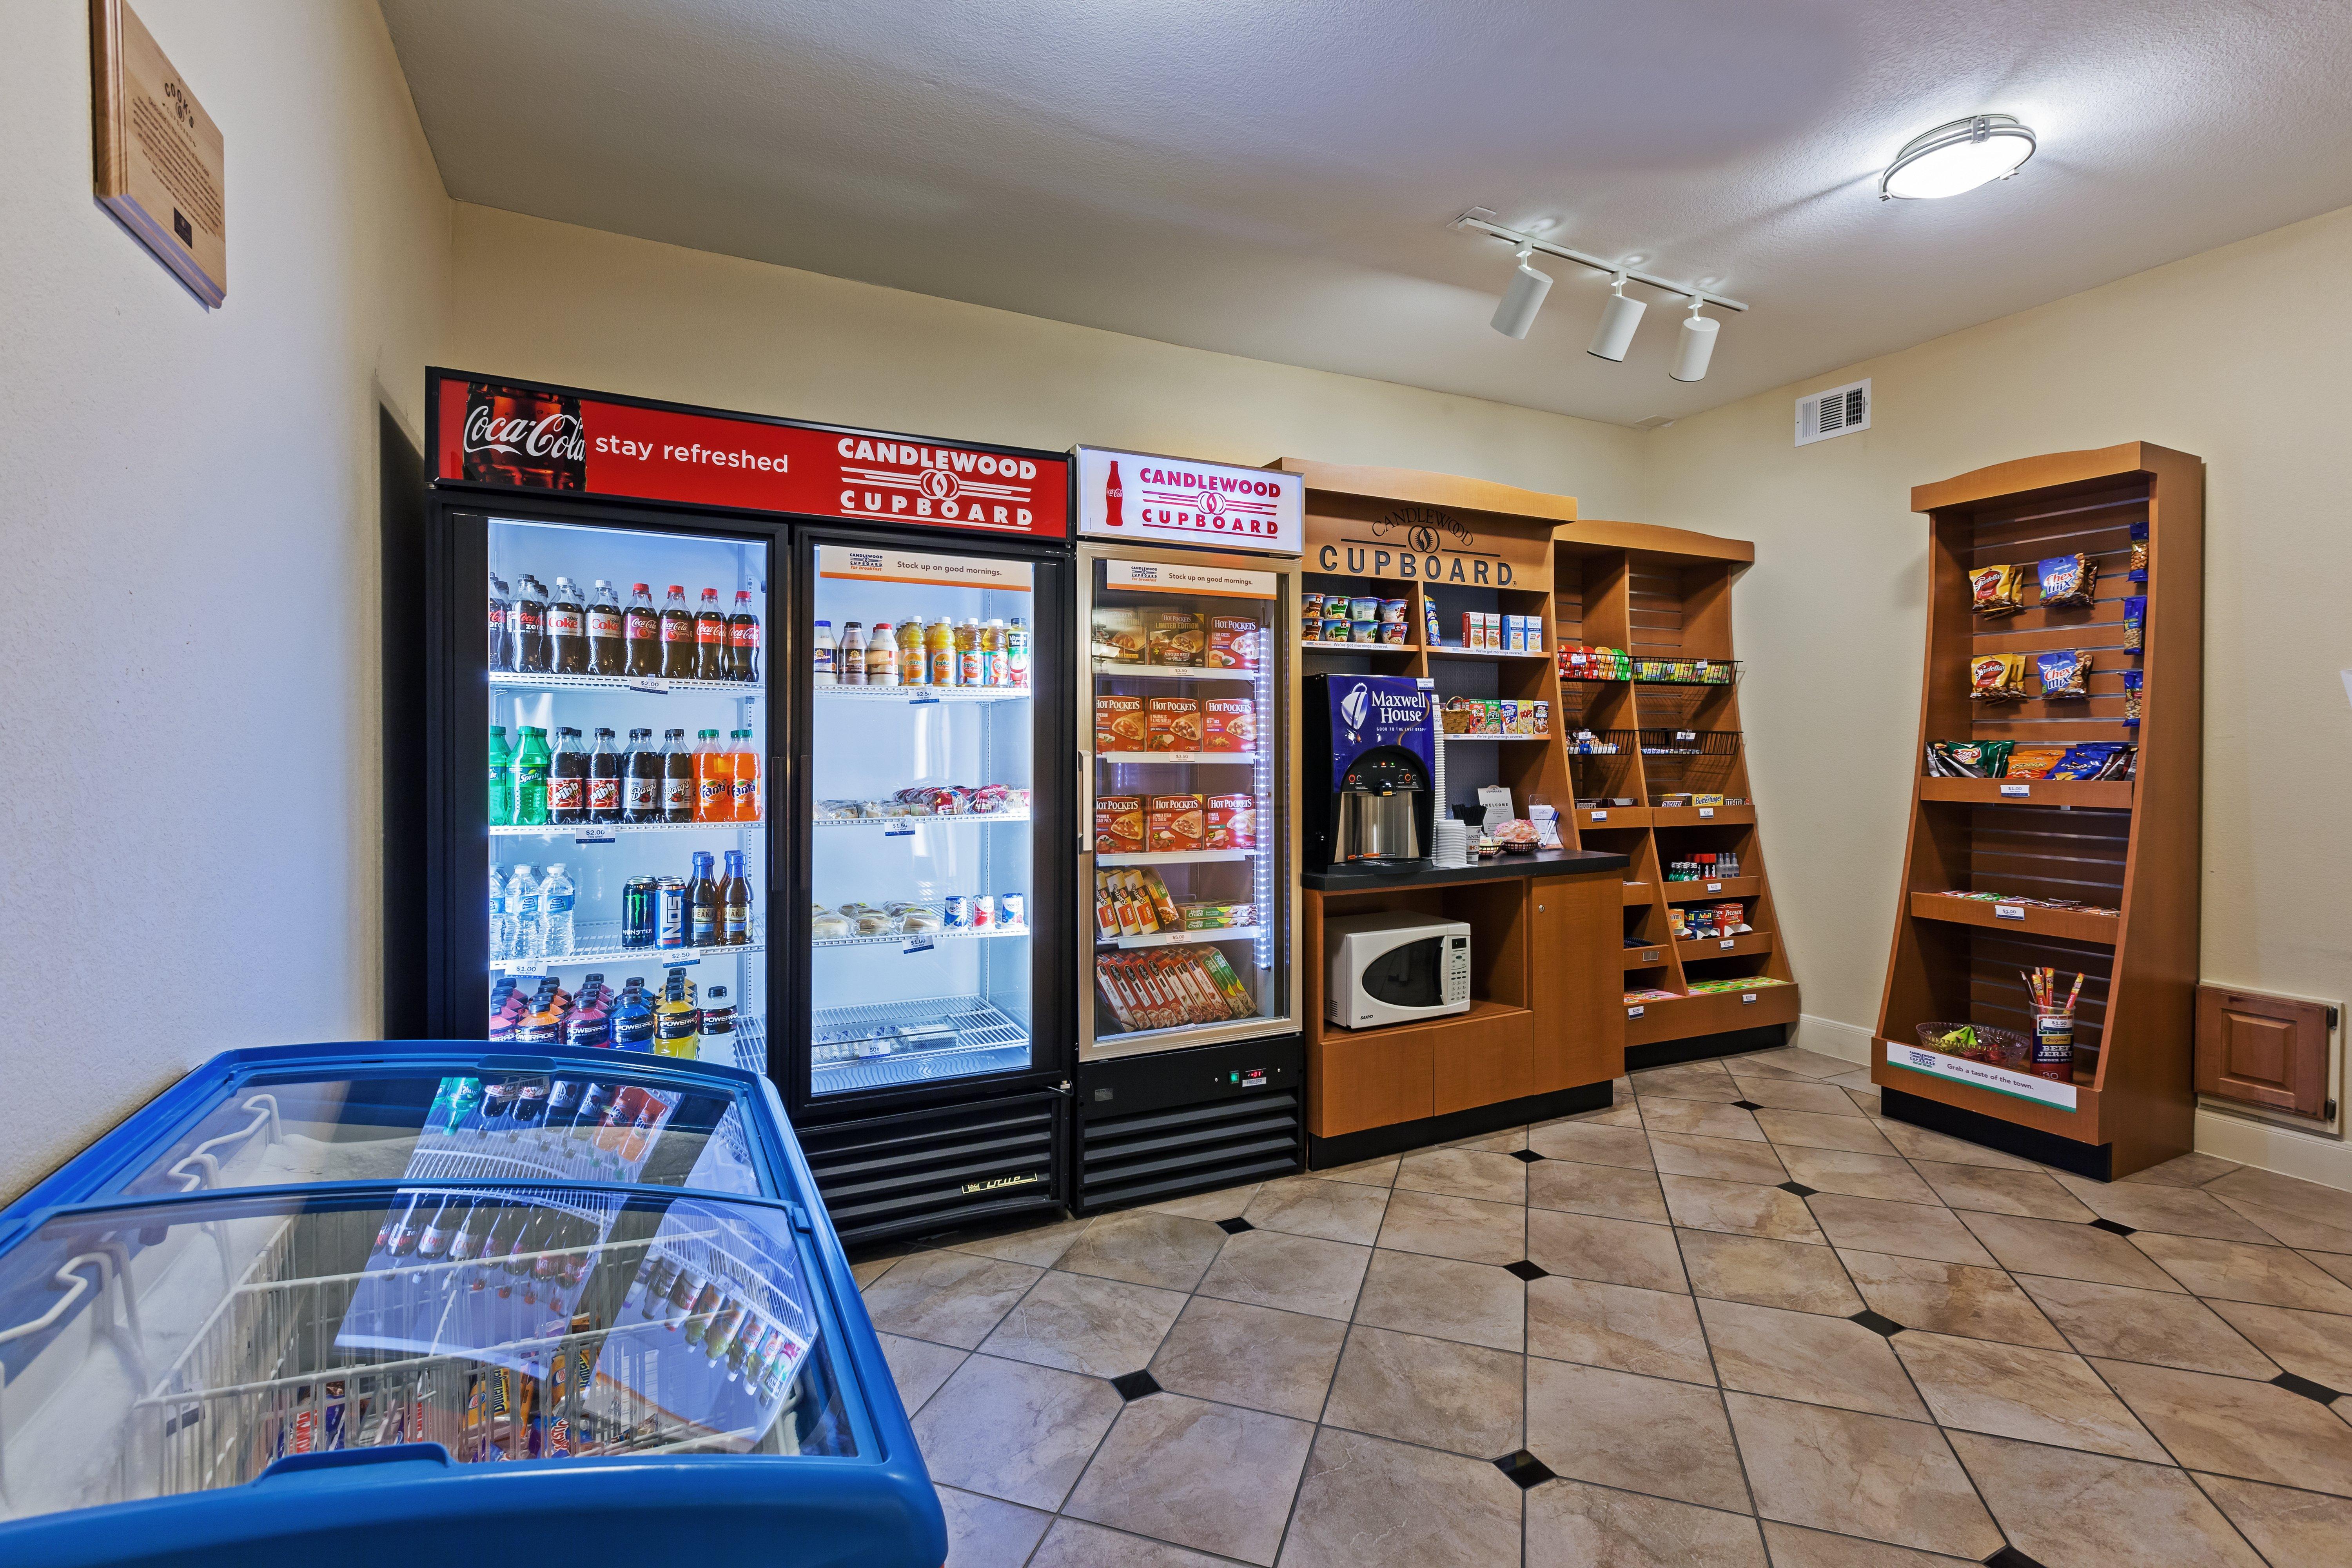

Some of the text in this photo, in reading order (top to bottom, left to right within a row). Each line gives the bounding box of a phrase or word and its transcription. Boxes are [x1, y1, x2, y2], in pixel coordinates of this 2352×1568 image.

[464, 405, 586, 462] Coca-Cola
[595, 434, 788, 473] stay refreshed
[838, 438, 1037, 479] CANDLEWOOD
[1140, 468, 1281, 498] CANDLEWOOD
[840, 490, 1033, 526] CUPBOARD
[1142, 508, 1278, 534] CUPBOARD
[1372, 508, 1474, 546] CANDLEWOOD
[897, 561, 918, 569] Stock
[966, 568, 1002, 576] mornings.
[1319, 545, 1512, 586] CUPBOARD
[1973, 573, 2003, 592] Gardetto's
[2046, 570, 2073, 584] Chex
[549, 616, 578, 628] Coke
[592, 619, 619, 631] Coke
[632, 618, 657, 629] Coca-Cola
[1214, 620, 1256, 630] HOT POCKETS
[728, 627, 759, 639] Coca-Cola
[1975, 664, 2005, 680] Gardetto's
[2045, 667, 2071, 680] Chex
[1109, 700, 1140, 711] POCKETS
[1152, 701, 1196, 712] HOT POCKETS
[1372, 691, 1426, 708] Maxwell
[1223, 704, 1252, 713] POCKETS
[1380, 708, 1422, 723] House
[1486, 714, 1499, 723] JACKS
[519, 773, 540, 783] Sprite
[552, 782, 579, 804] Pibb
[590, 783, 615, 804] Pibb
[631, 781, 656, 802] Barq's
[664, 781, 690, 802] Barq's
[700, 783, 725, 799] Fanta
[731, 784, 756, 799] Fanta
[1108, 800, 1138, 810] POCKETS
[1170, 800, 1198, 810] POCKETS
[1210, 799, 1252, 808] HOT POCKETS
[1695, 795, 1722, 806] Butterfinger
[662, 895, 681, 938] NOS
[1126, 965, 1136, 982] Stouffer's
[567, 1025, 608, 1034] POWERADE
[1909, 1051, 1936, 1060] CANDLEWOOD
[1947, 1063, 1963, 1072] Grab
[1971, 1069, 1988, 1078] taste
[2013, 1080, 2034, 1090] town.
[987, 1176, 1020, 1188] true
